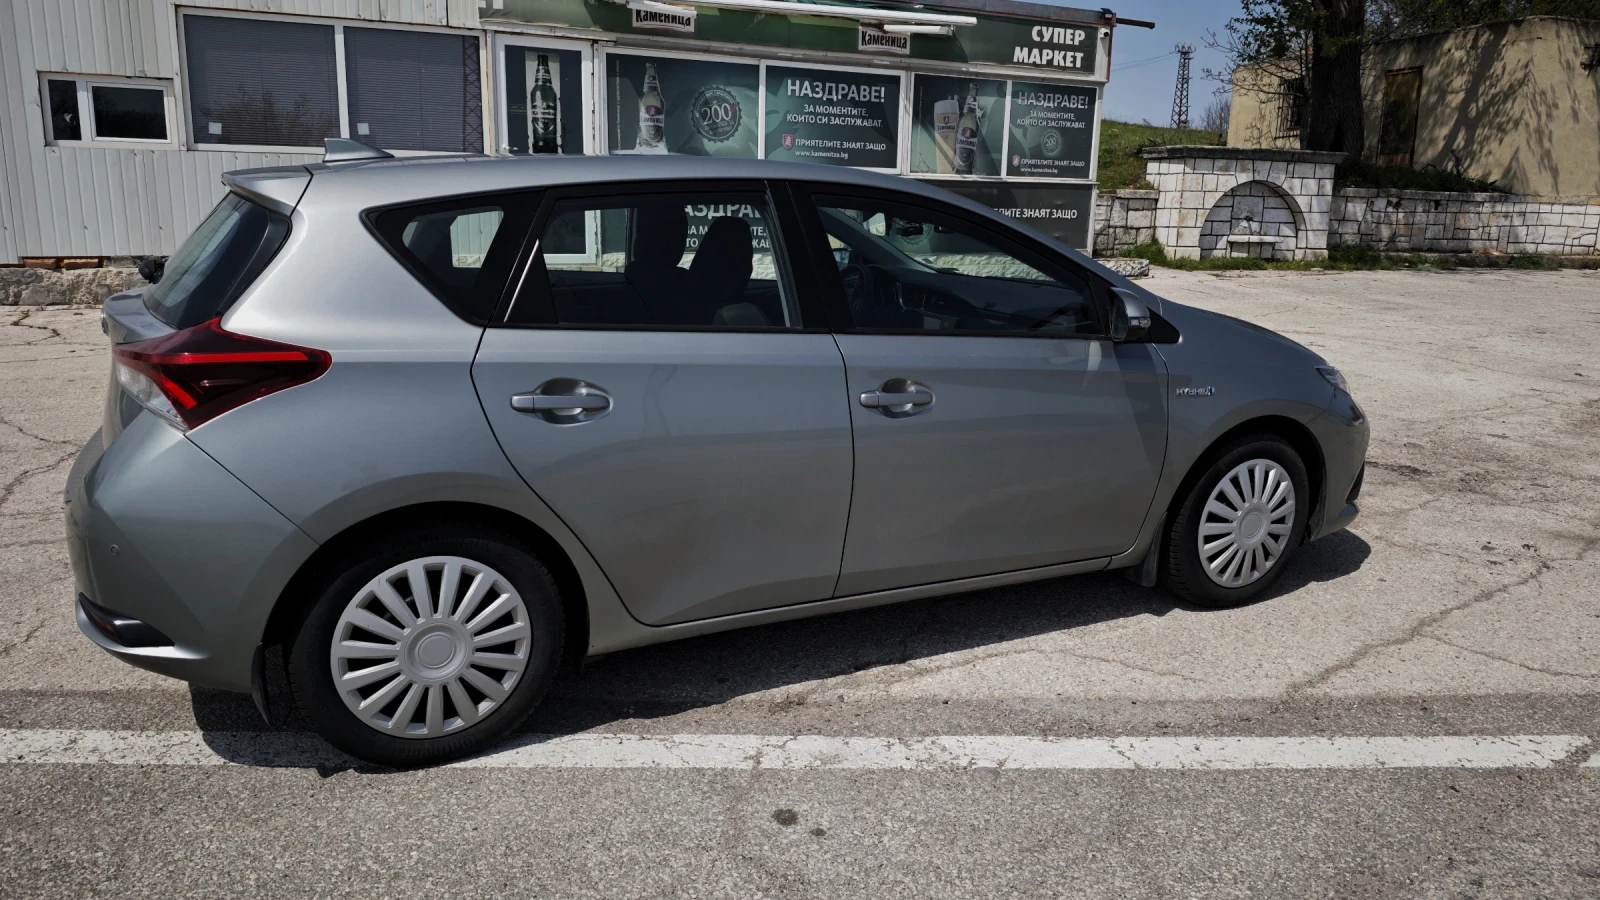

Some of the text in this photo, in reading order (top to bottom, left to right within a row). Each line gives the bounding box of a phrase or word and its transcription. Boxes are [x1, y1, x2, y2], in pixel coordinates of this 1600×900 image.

[635, 9, 691, 27] Каменица
[861, 30, 908, 50] Каменица
[1031, 25, 1086, 46] СУПЕР
[1013, 46, 1084, 68] МАРКЕТ
[787, 79, 885, 103] НАЗДРАВЕ!
[1018, 91, 1089, 109] НАЗДРАВЕ!
[701, 103, 732, 125] 200
[803, 104, 869, 117] ЗА МОМЕНТИТЕ,
[1029, 110, 1076, 120] ЗА МОМЕНТИТЕ,
[786, 113, 884, 128] КОИТО СИ ЗАСЛУЖАВАТ.
[1016, 118, 1038, 126] КОИТО
[1038, 119, 1047, 127] СИ
[795, 138, 887, 151] ПРИЯТЕЛИТЕ ЗНАЯТ ЗАЩО
[795, 150, 849, 159] www.kamenitza.bg
[1020, 158, 1085, 168] ПРИЯТЕЛИТЕ ЗНАЯТ ЗАЩО
[1022, 208, 1051, 219] ЗНАЯТ
[1051, 209, 1078, 220] ЗАЩО
